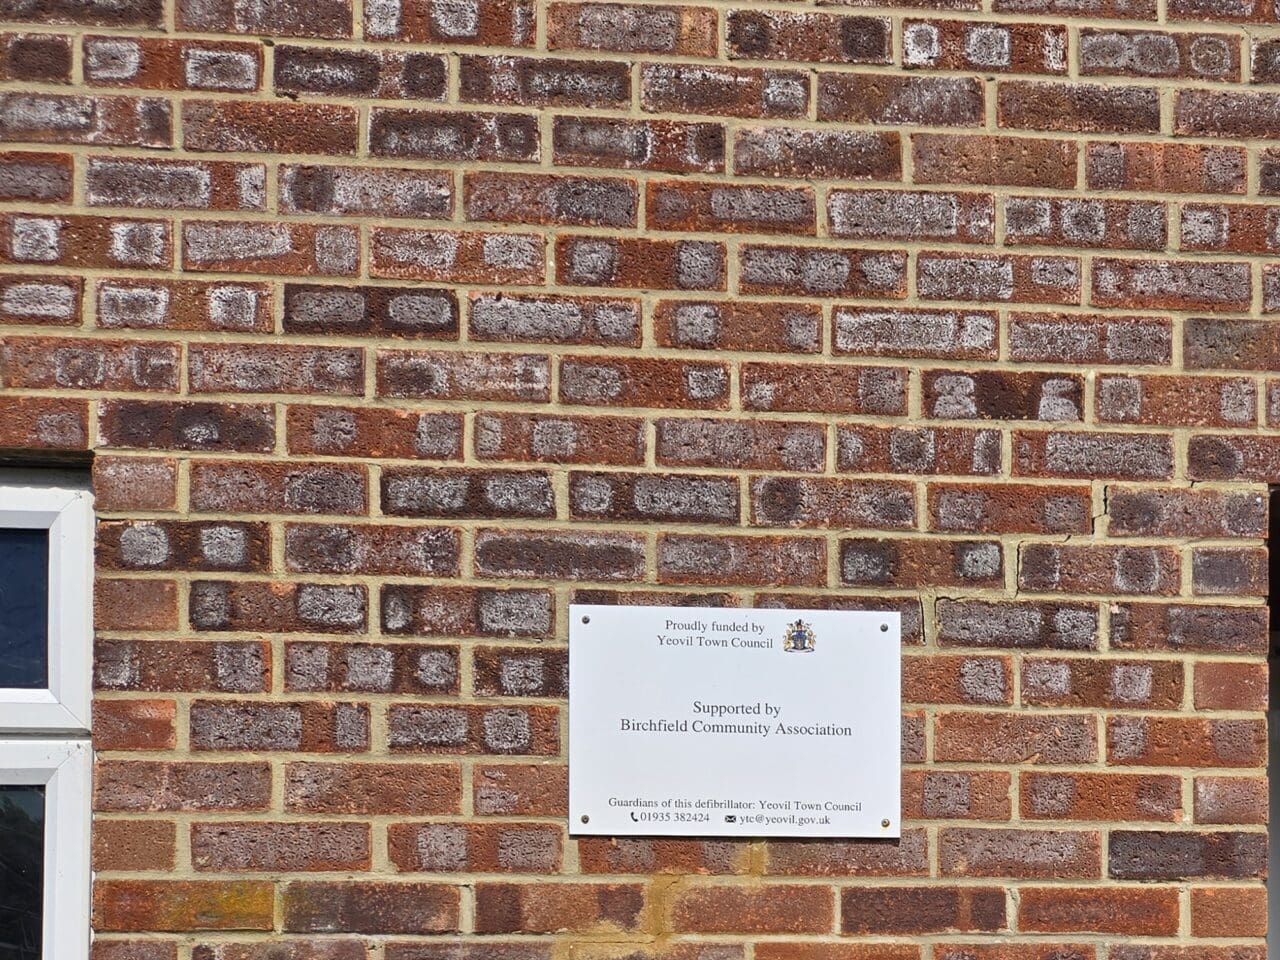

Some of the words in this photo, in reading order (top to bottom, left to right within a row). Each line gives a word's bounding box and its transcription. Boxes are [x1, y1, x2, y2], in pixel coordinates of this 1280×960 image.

[665, 619, 708, 634] Proudly
[711, 620, 749, 632] funded
[751, 622, 765, 635] by
[657, 635, 694, 647] Yeovil
[696, 636, 729, 648] Town
[731, 637, 773, 649] Council
[693, 701, 761, 717] Supported
[764, 702, 781, 718] by
[620, 718, 688, 733] Birchfield
[692, 720, 771, 737] Community
[775, 722, 852, 736] Association
[608, 797, 658, 809] Guardians
[661, 798, 673, 809] of
[674, 798, 692, 809] this
[695, 799, 756, 810] defibrillator:
[759, 800, 791, 811] Yeovil
[795, 801, 822, 811] Town
[824, 801, 862, 812] Council
[640, 812, 670, 823] 01935
[673, 812, 710, 823] 382424
[739, 814, 831, 827] ytc@yeovil.gov.uk
